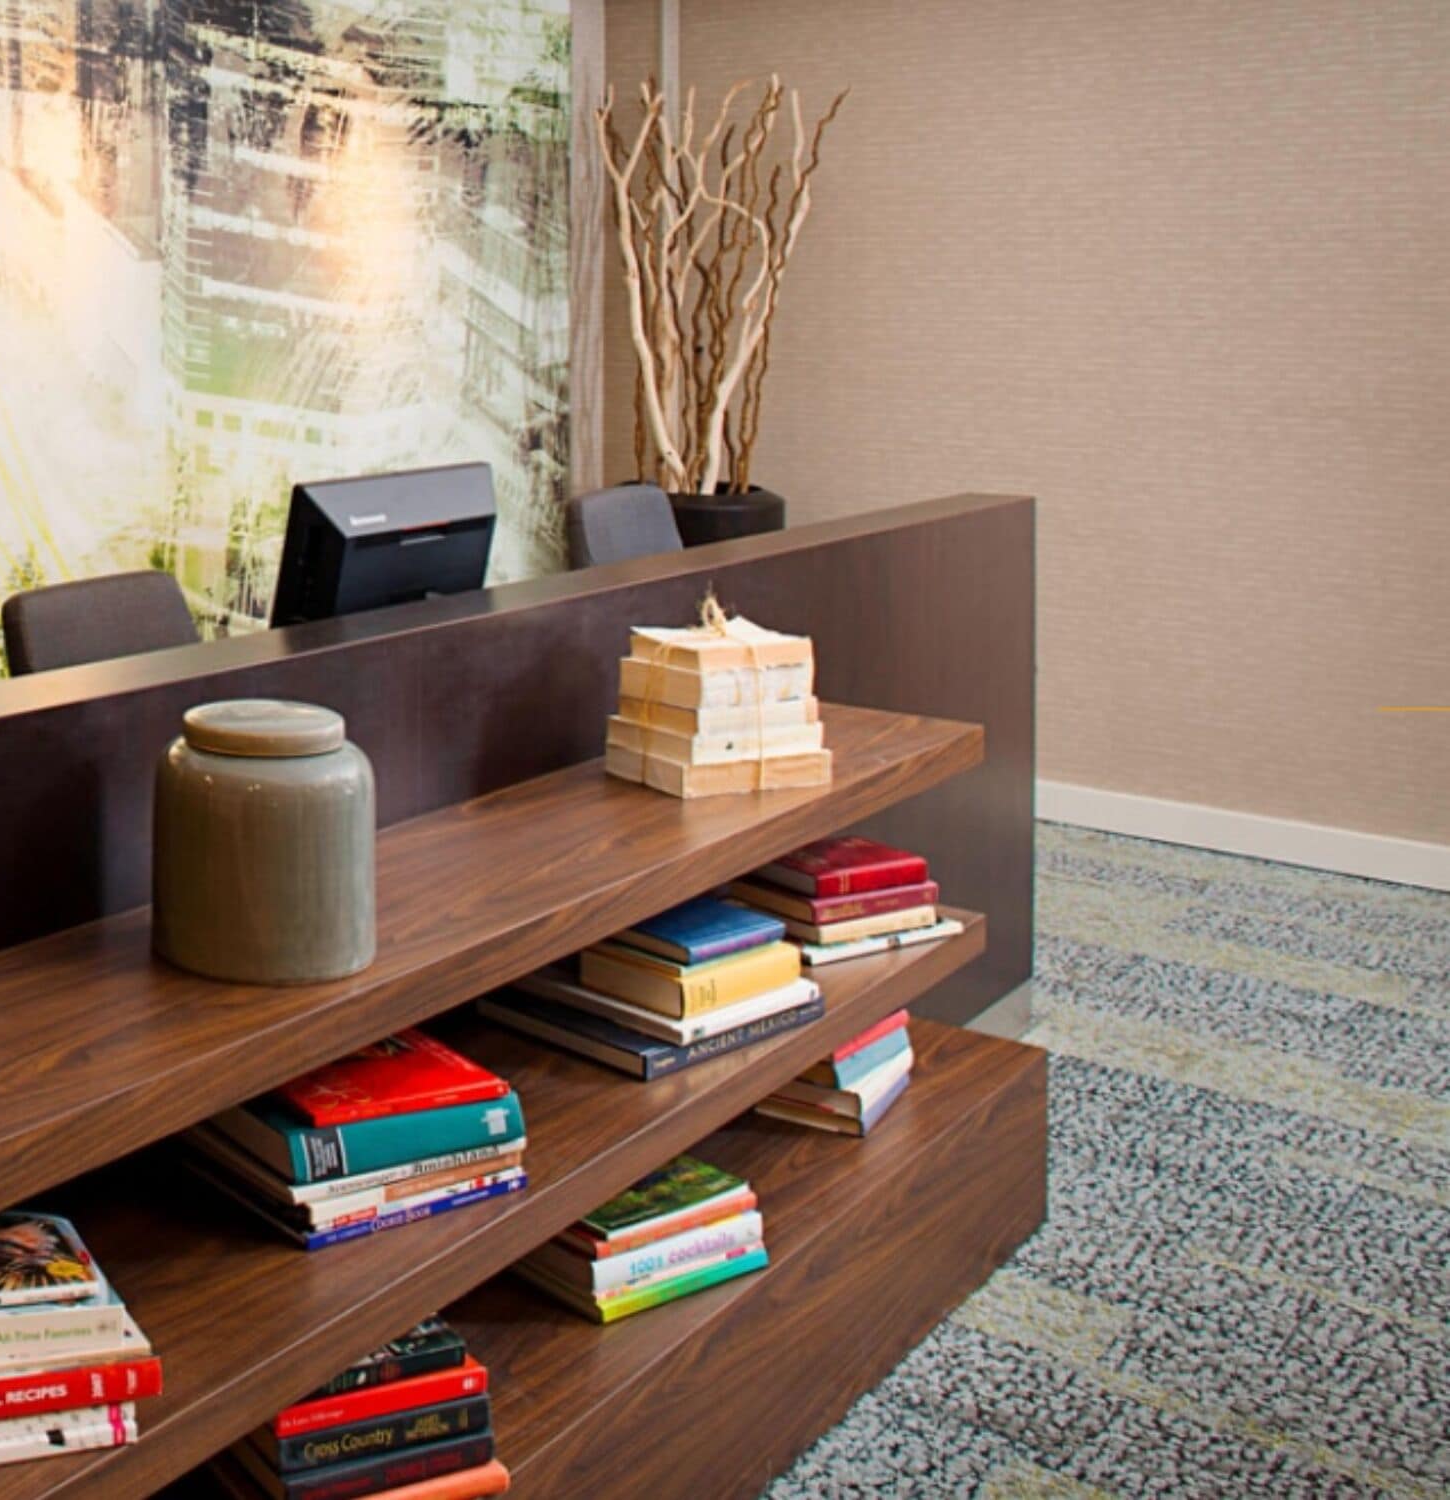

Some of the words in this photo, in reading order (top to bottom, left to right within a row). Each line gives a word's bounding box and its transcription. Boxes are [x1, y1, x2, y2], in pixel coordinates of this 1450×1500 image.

[668, 1233, 735, 1264] cocktails
[6, 1384, 68, 1406] RECIPES
[304, 1438, 339, 1461] Cross
[341, 1427, 393, 1450] Country
